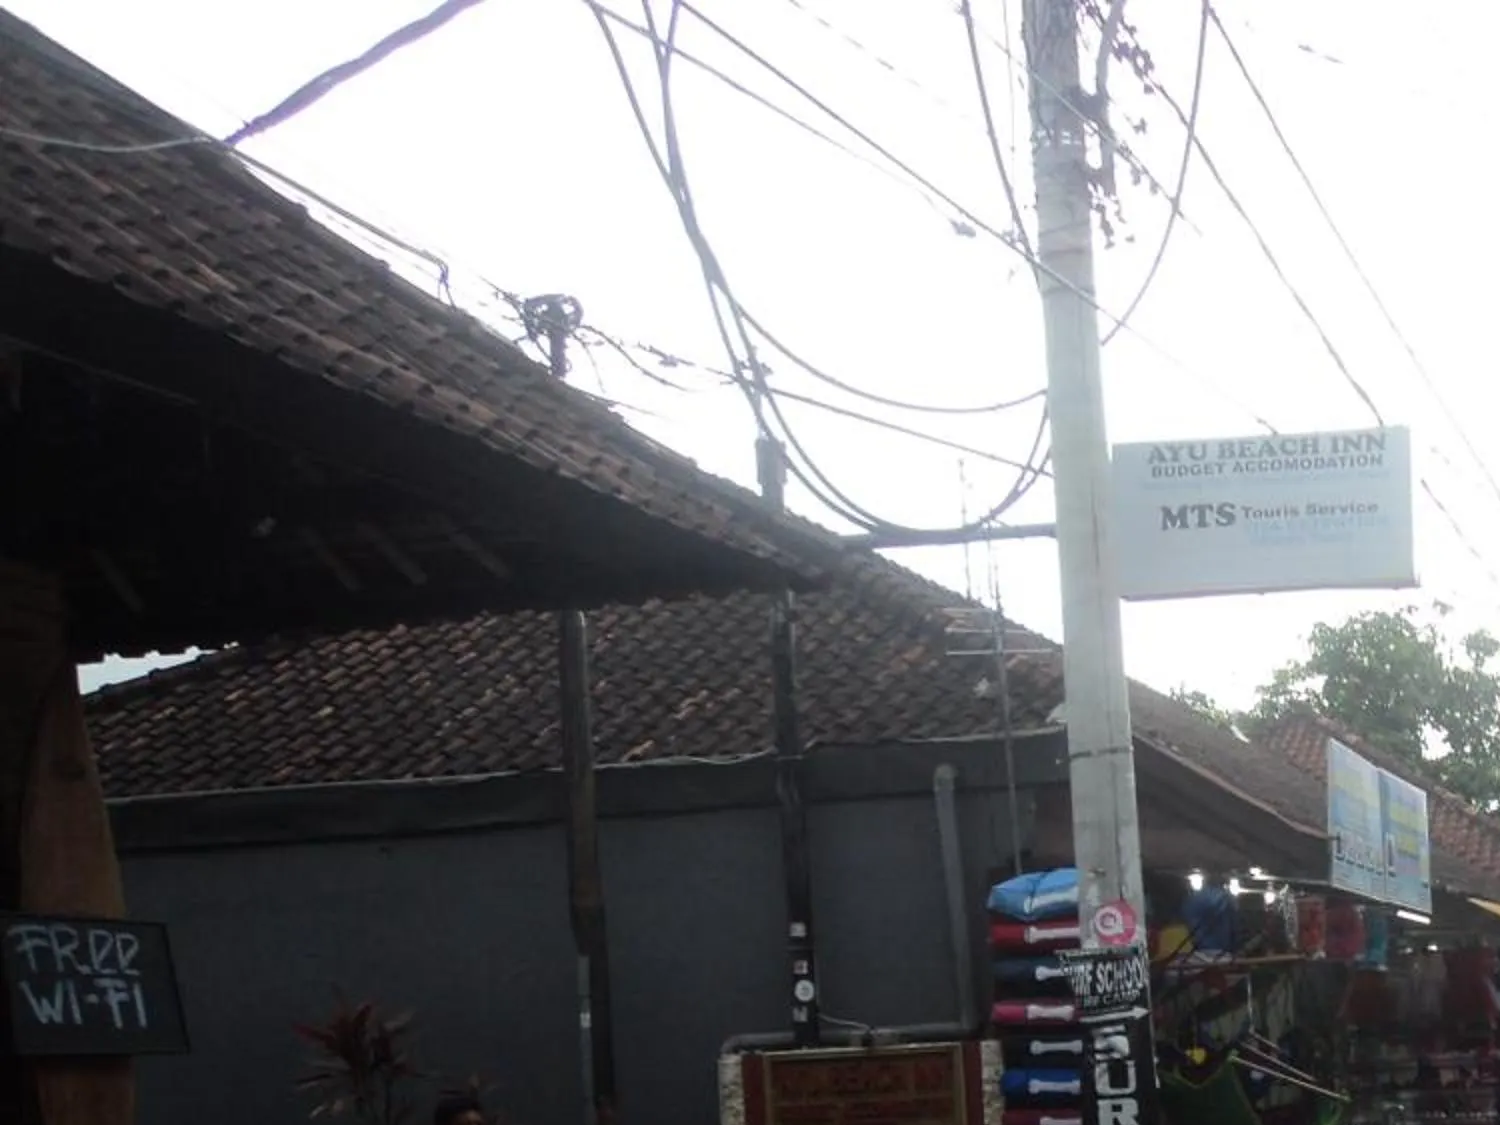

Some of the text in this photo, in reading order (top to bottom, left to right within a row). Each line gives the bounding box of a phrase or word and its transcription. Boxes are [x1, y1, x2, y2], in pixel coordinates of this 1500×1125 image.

[1148, 432, 1387, 464] AYU BEACH INN
[1151, 454, 1384, 479] BUDGET ACCOMODATION
[1160, 501, 1237, 531] MTS
[1305, 501, 1379, 517] Service
[18, 977, 148, 1030] WI-FI
